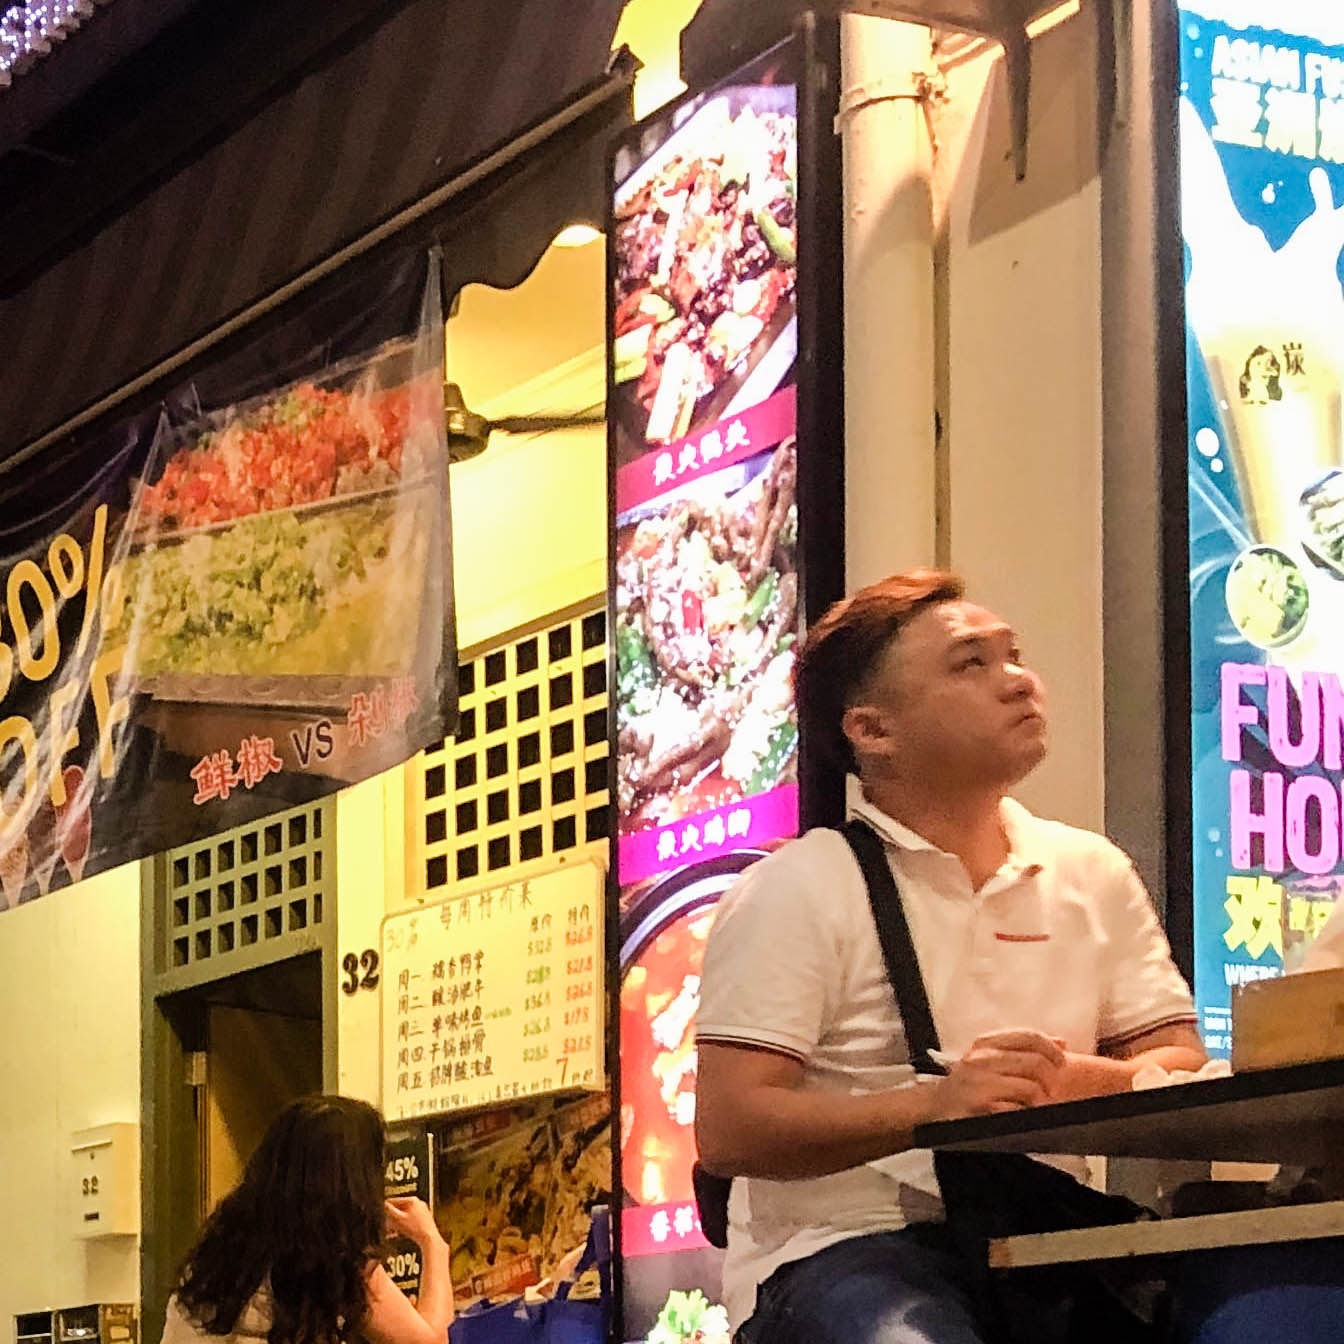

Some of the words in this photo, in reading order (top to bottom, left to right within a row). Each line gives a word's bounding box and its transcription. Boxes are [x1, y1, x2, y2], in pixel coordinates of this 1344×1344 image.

[190, 734, 283, 805] 鲜椒
[291, 718, 334, 769] VS
[1229, 769, 1344, 875] HO
[342, 949, 380, 995] 32
[385, 1155, 419, 1182] 45%
[387, 1252, 420, 1278] 30%
